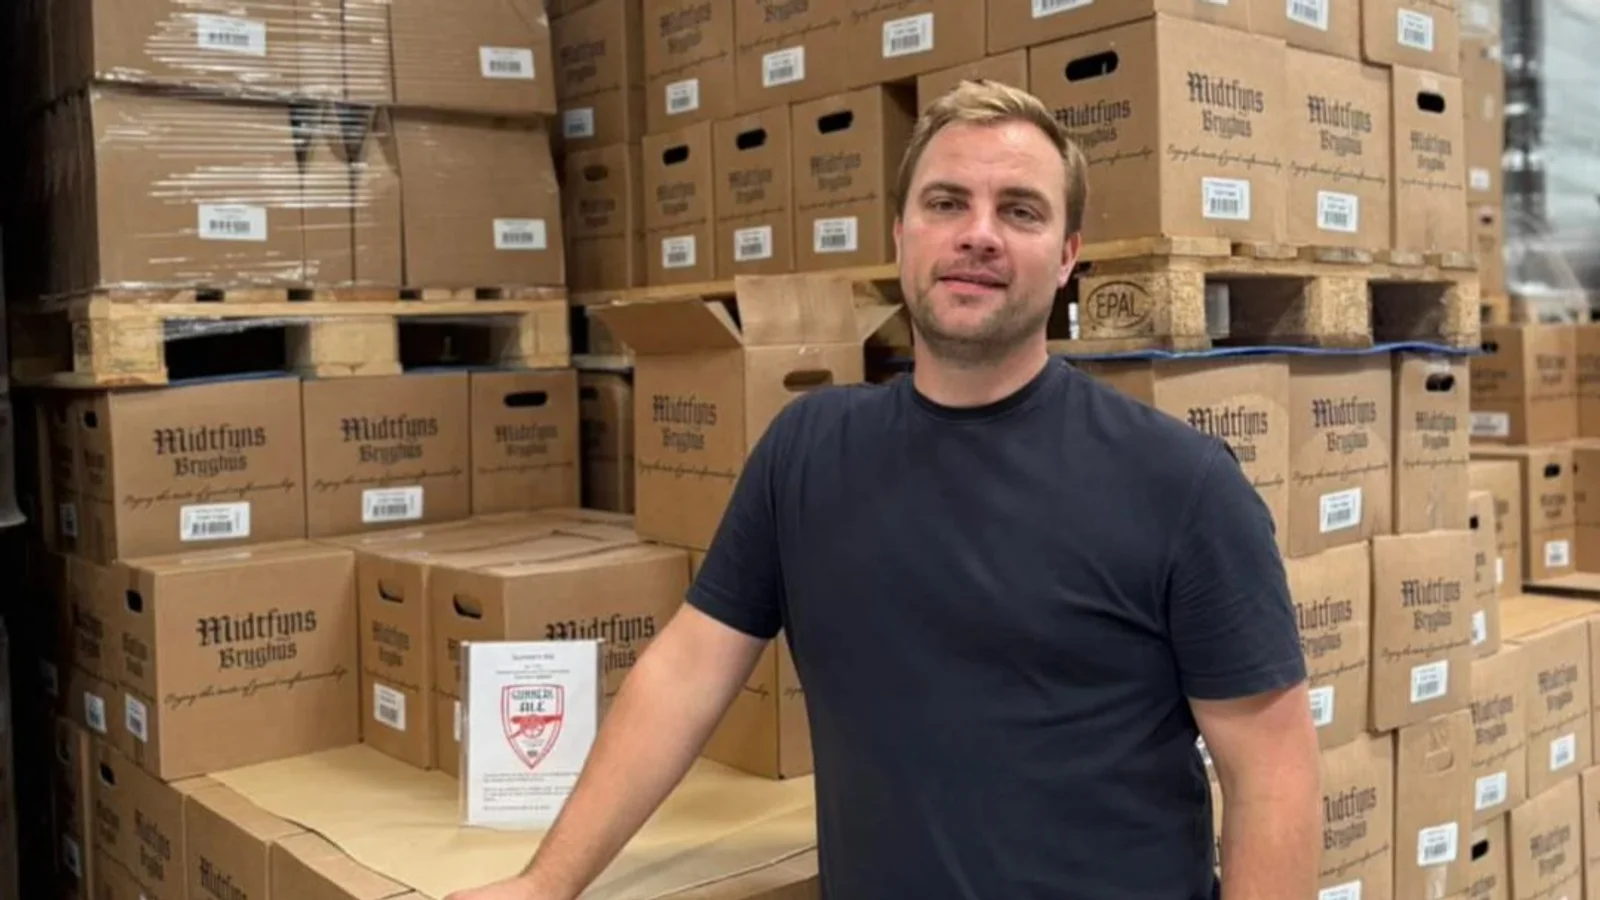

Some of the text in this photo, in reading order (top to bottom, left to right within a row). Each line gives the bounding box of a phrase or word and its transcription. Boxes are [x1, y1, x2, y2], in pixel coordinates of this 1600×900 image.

[1187, 71, 1265, 115] Midtfyns
[1095, 293, 1142, 320] EPAL
[153, 423, 266, 455] Midtfyns
[341, 414, 438, 443] Midtfyns
[174, 455, 248, 478] Bryghus
[196, 607, 317, 647] Midtfyns
[218, 641, 298, 672] Bryghus
